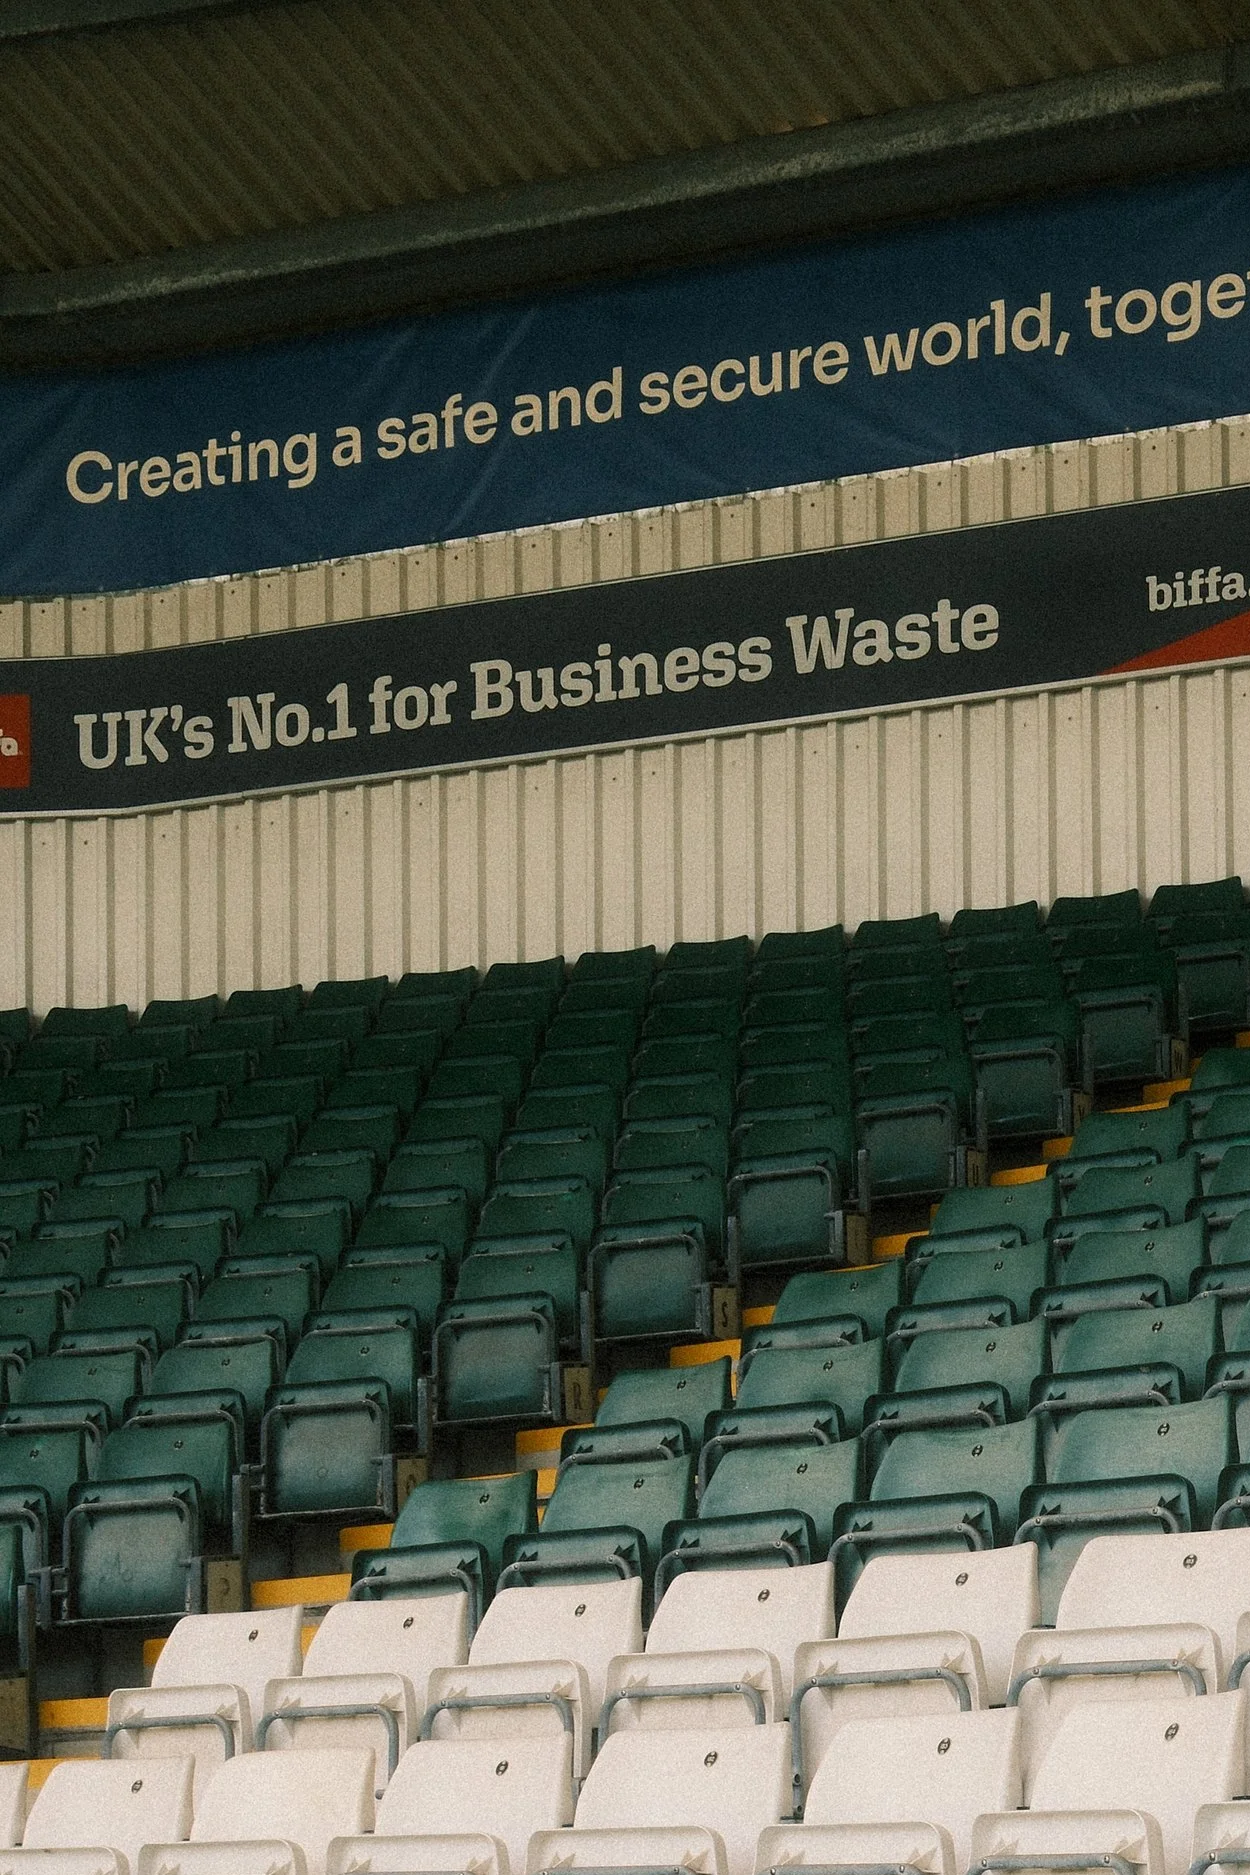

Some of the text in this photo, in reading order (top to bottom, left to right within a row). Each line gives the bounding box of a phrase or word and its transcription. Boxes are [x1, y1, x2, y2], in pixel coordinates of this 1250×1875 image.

[66, 430, 317, 504] Creating
[332, 426, 362, 467] a
[377, 393, 498, 460] safe
[510, 366, 623, 436] and
[639, 341, 849, 415] secure
[863, 292, 1070, 376] world,
[74, 704, 215, 770] UK's
[228, 683, 358, 754] No.1
[369, 675, 458, 735] for
[470, 634, 773, 720] Business
[785, 598, 999, 674] Waste
